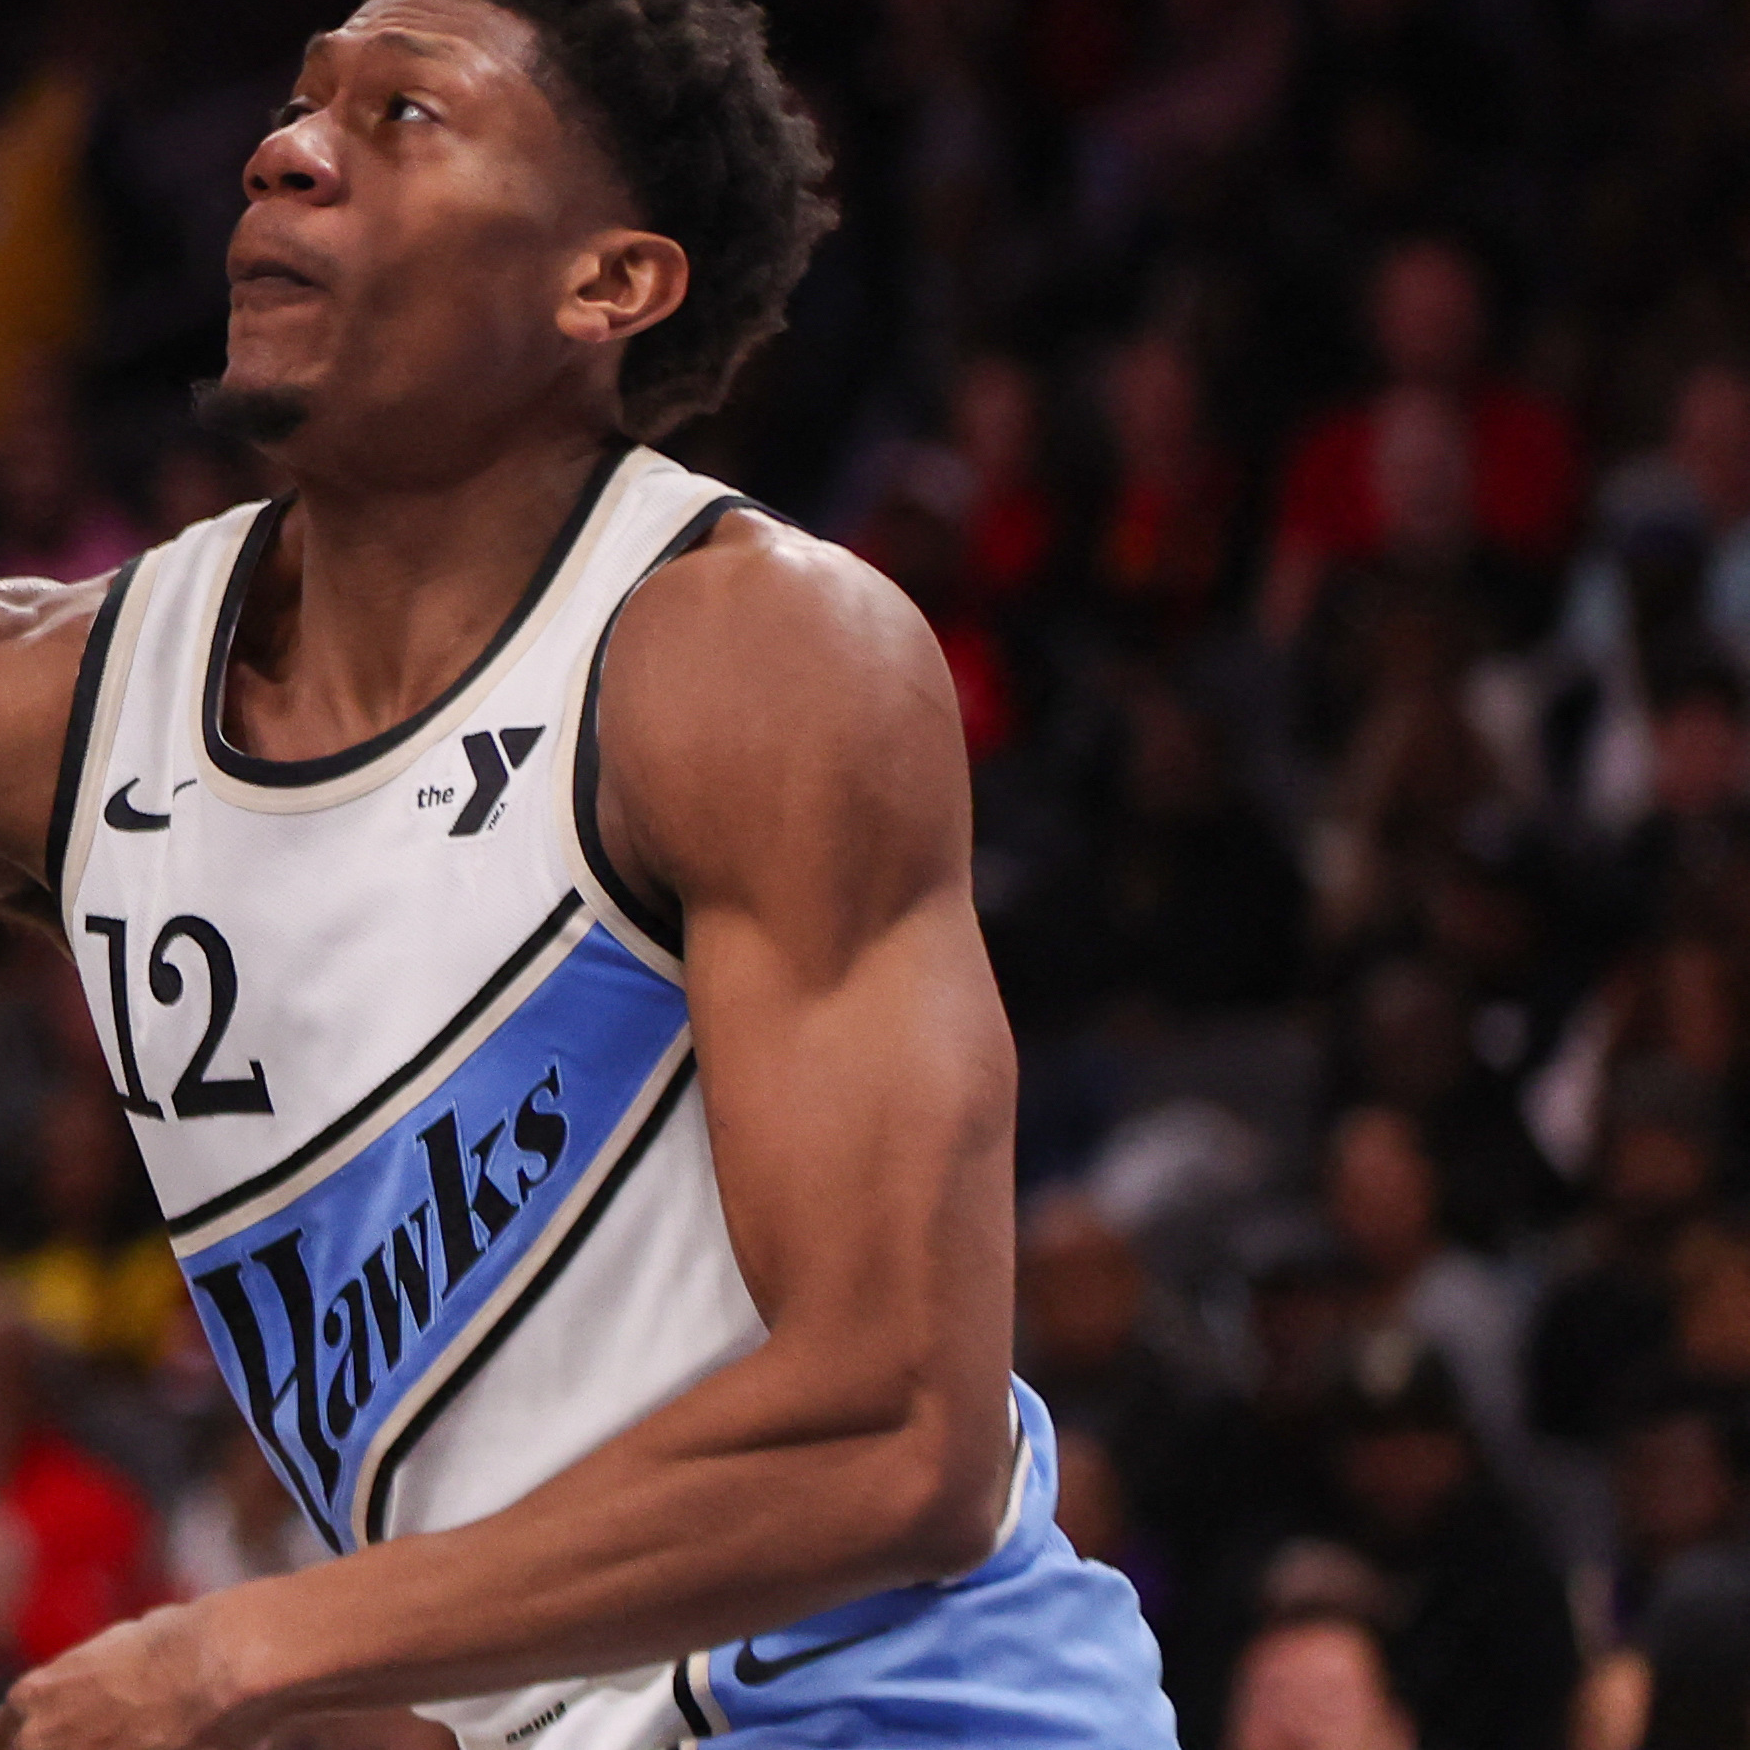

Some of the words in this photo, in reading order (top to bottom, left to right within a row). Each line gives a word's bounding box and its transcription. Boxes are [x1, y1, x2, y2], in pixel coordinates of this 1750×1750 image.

[417, 784, 455, 809] the
[85, 914, 275, 1120] 12
[190, 1054, 570, 1556] Hawks
